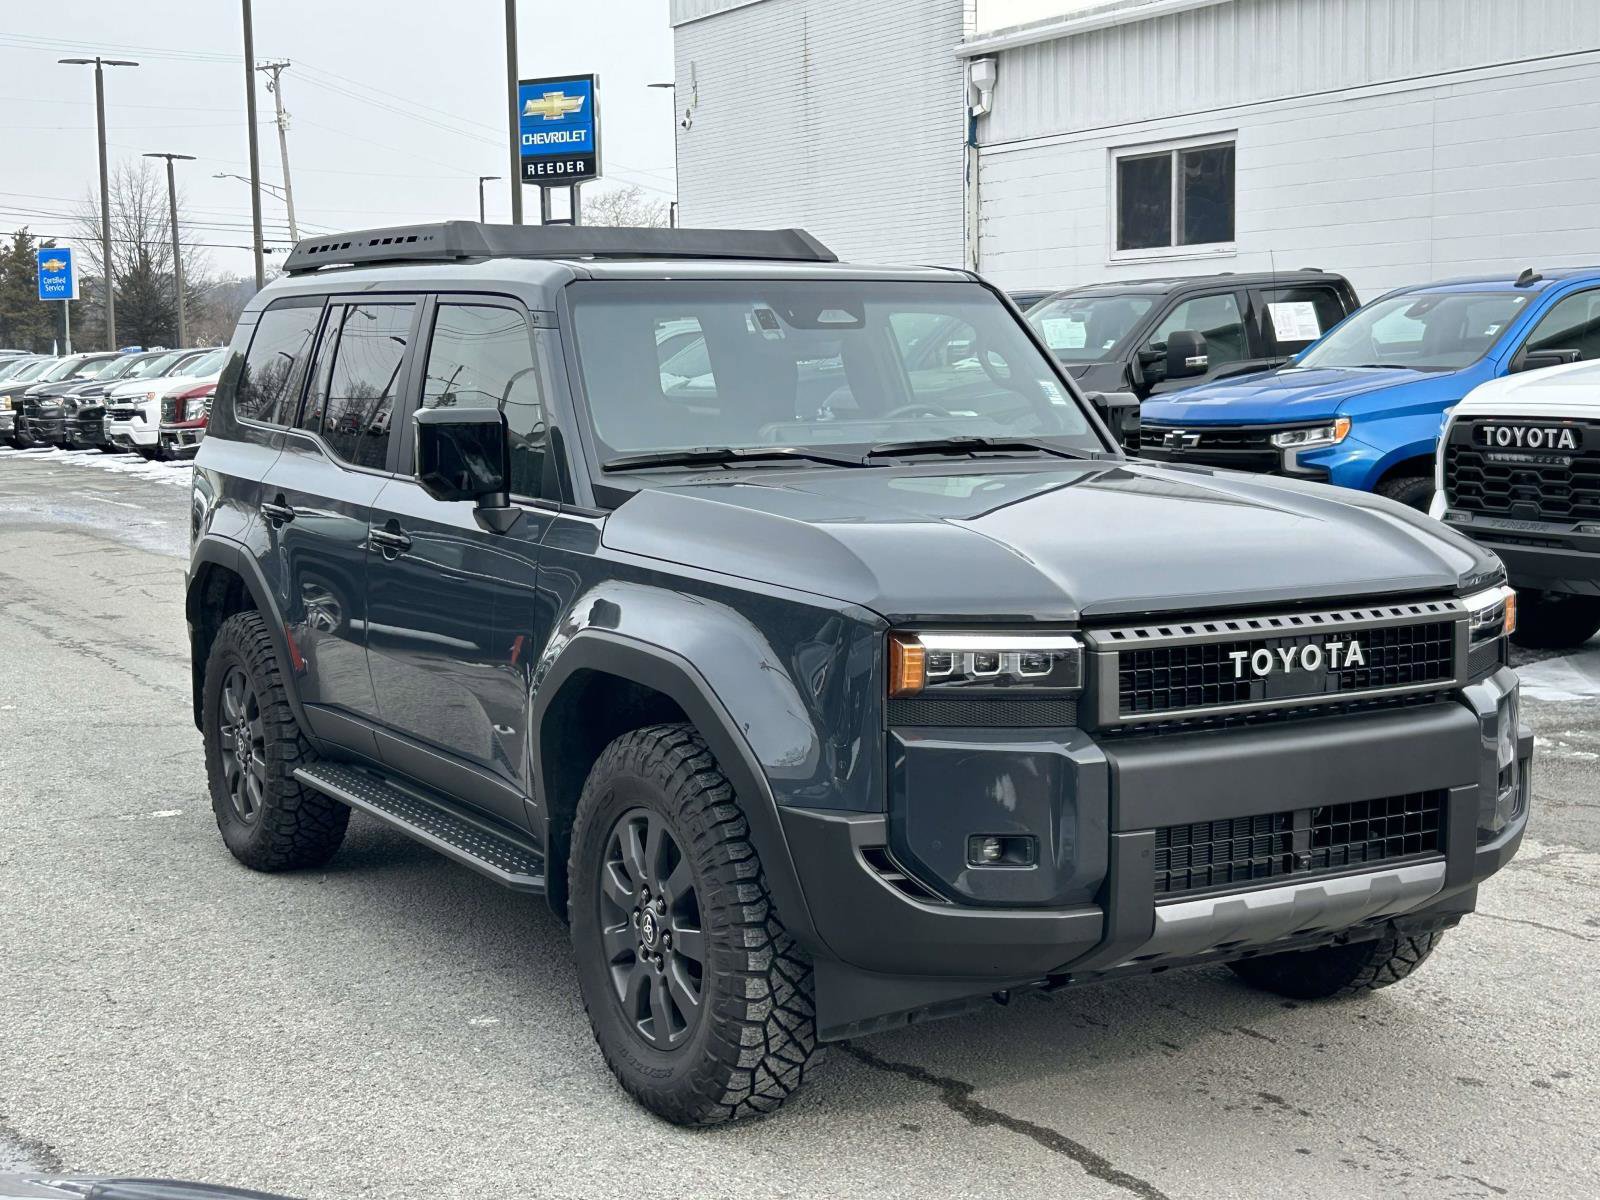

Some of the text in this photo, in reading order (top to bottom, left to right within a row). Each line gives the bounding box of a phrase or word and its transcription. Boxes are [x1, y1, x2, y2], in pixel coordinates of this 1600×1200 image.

[522, 129, 587, 145] CHEVROLET
[527, 161, 585, 175] REEDER
[43, 276, 66, 284] Certified
[45, 284, 65, 292] Service
[1483, 426, 1576, 449] TOYOTA
[1229, 640, 1365, 678] TOYOTA
